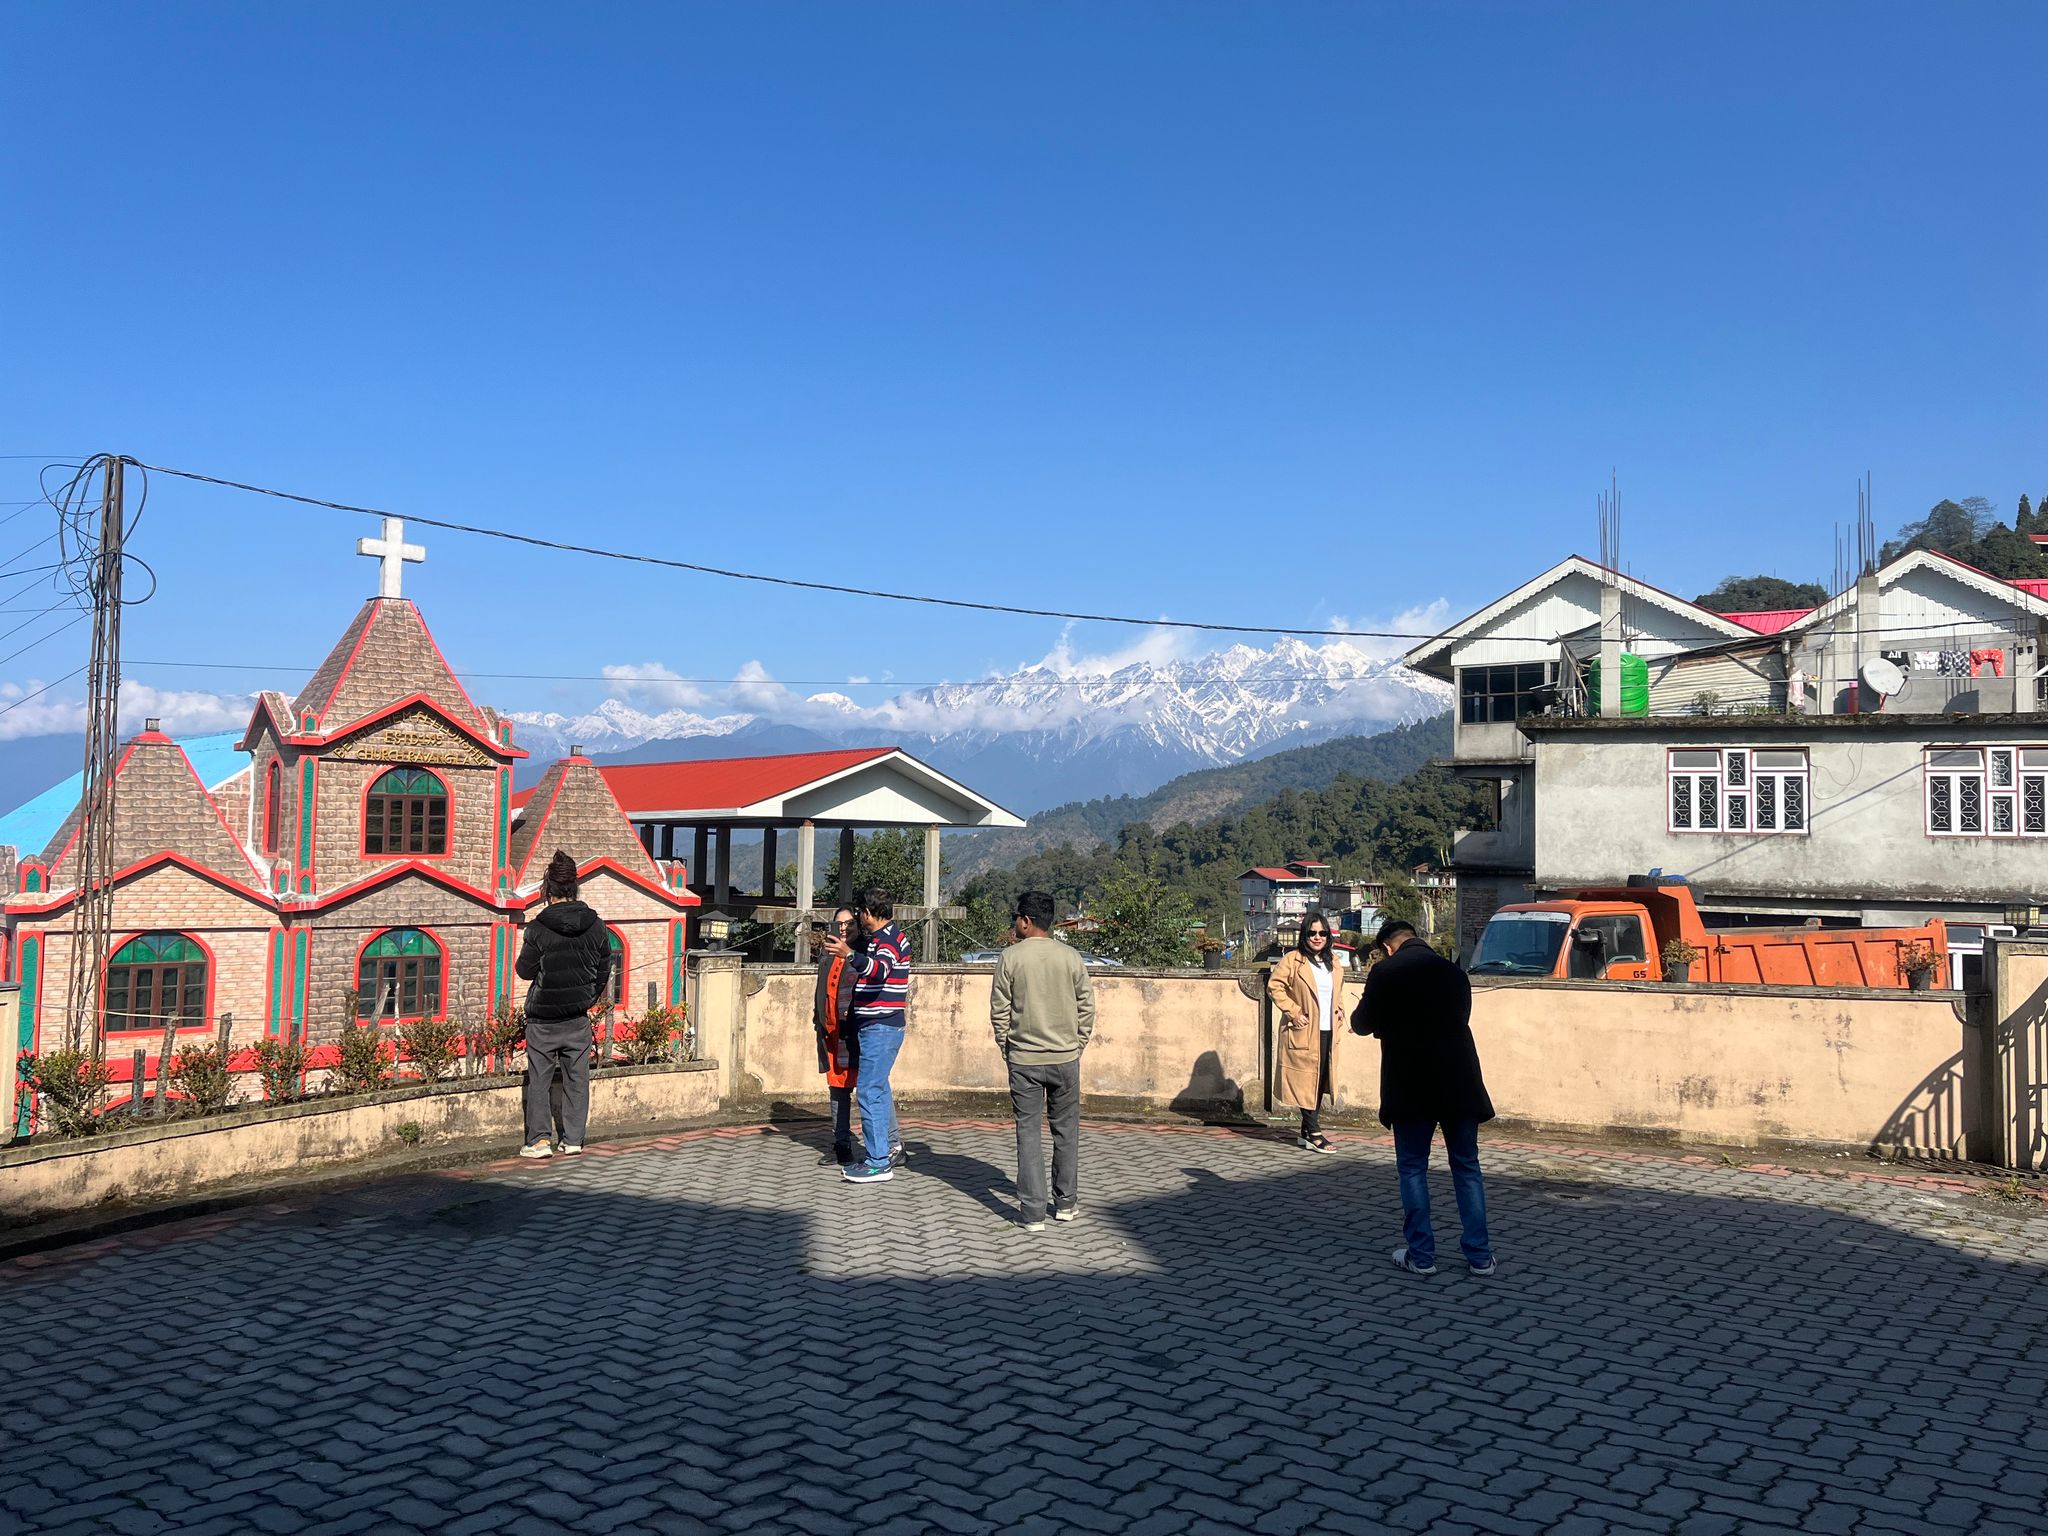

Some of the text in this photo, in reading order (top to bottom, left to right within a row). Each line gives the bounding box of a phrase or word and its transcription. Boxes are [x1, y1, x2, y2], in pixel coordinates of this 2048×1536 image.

[411, 710, 489, 766] FELLOWSHIP
[356, 748, 471, 765] CHURCH RAVANGLA
